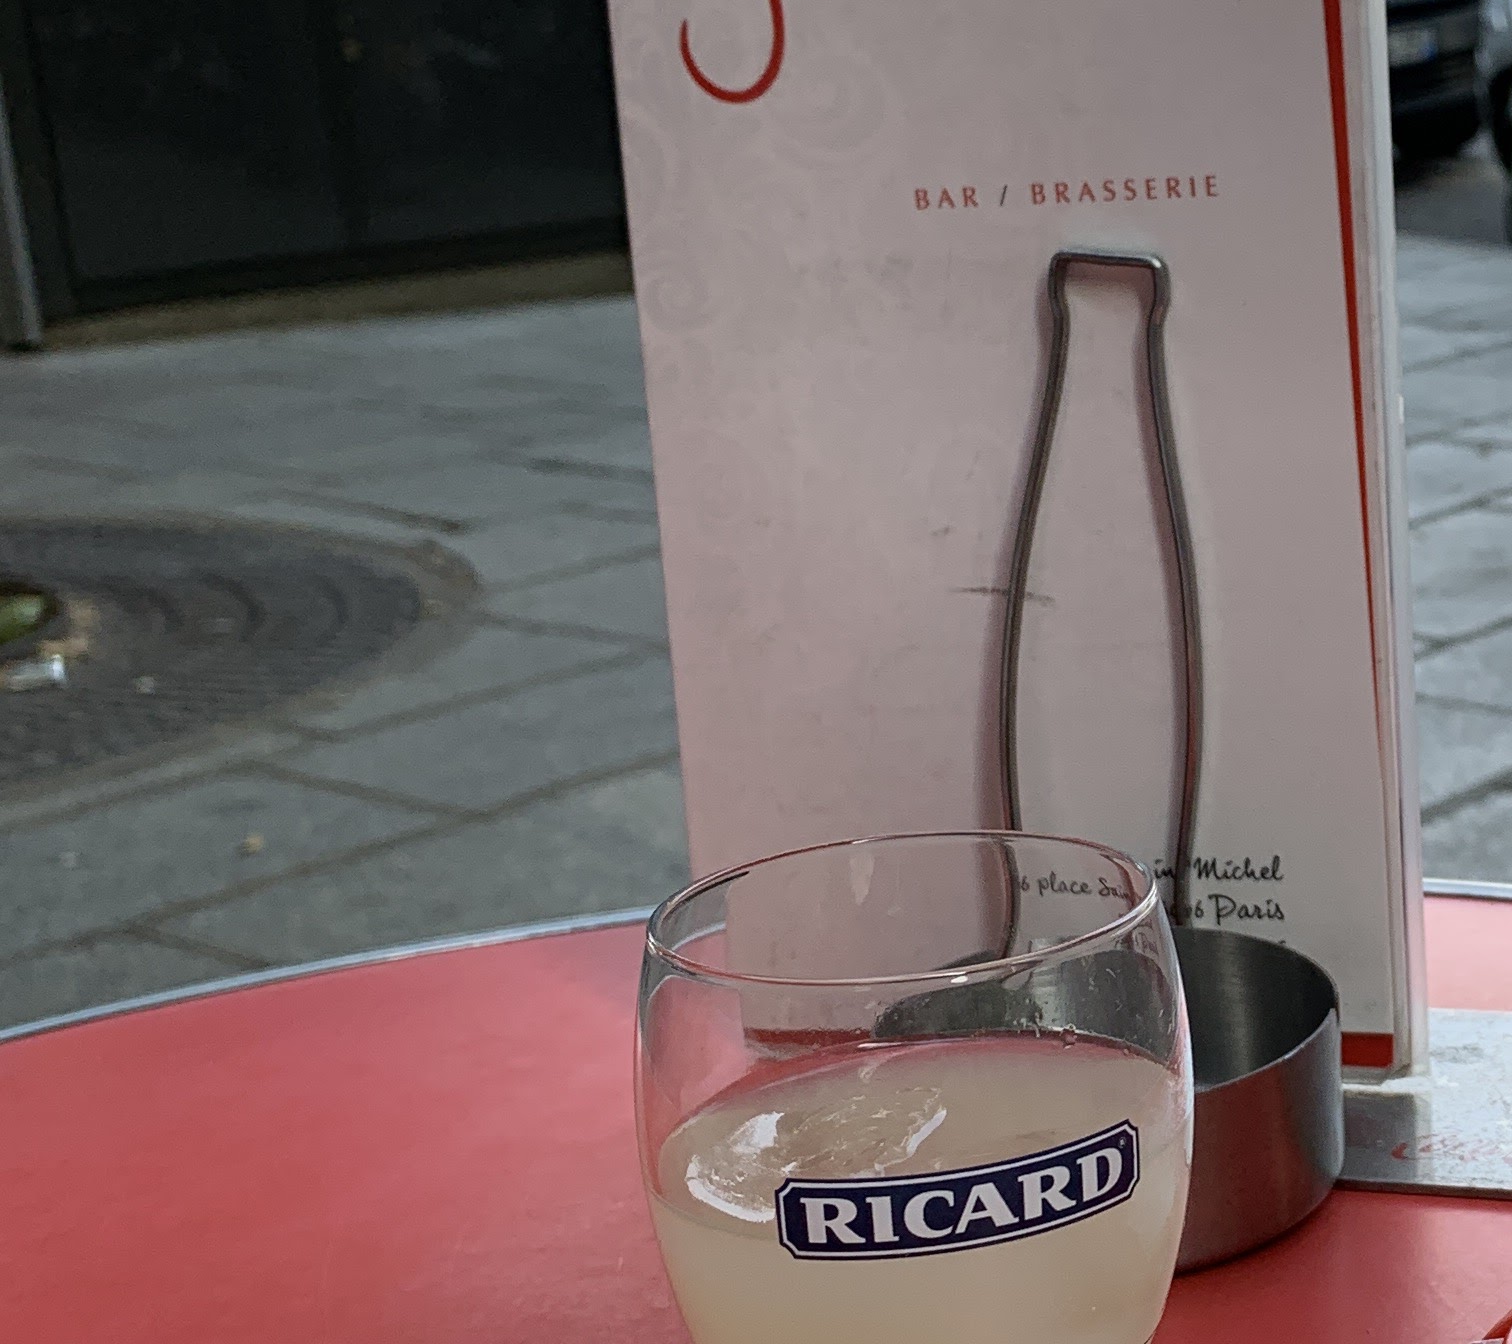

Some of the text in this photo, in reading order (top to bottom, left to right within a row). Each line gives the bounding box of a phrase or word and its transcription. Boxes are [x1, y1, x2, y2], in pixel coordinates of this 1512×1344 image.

[914, 186, 979, 210] BAR
[1029, 175, 1219, 205] BRASSERIE
[1037, 871, 1092, 898] place
[1193, 854, 1285, 881] Michel
[1207, 893, 1285, 926] Paris
[800, 1146, 1123, 1245] RICARD
